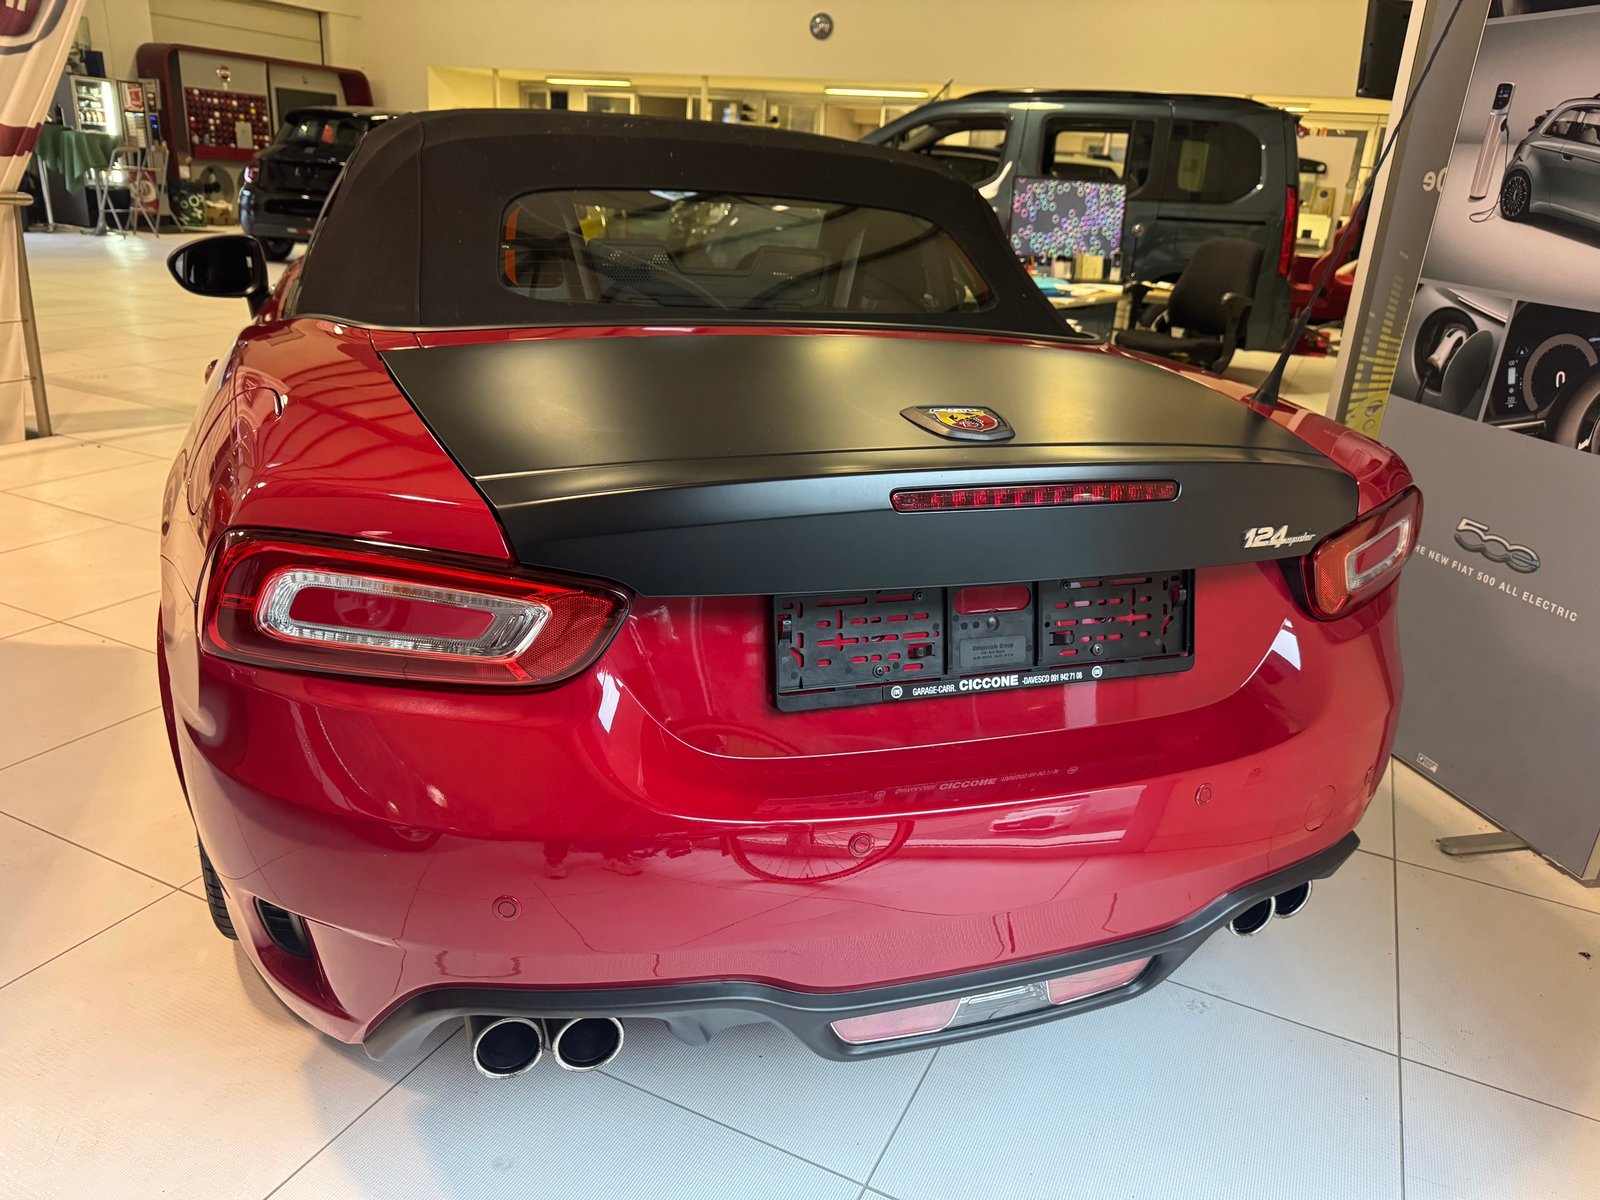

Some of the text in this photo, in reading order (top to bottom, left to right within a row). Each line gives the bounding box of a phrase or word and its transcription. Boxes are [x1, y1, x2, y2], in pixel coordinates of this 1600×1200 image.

[1244, 524, 1289, 549] 124
[1414, 544, 1579, 622] HE NEW FIAT 500 ALL ELECTRIC
[959, 674, 1019, 692] CICCONE
[1060, 672, 1070, 681] 942
[1069, 672, 1076, 680] 71
